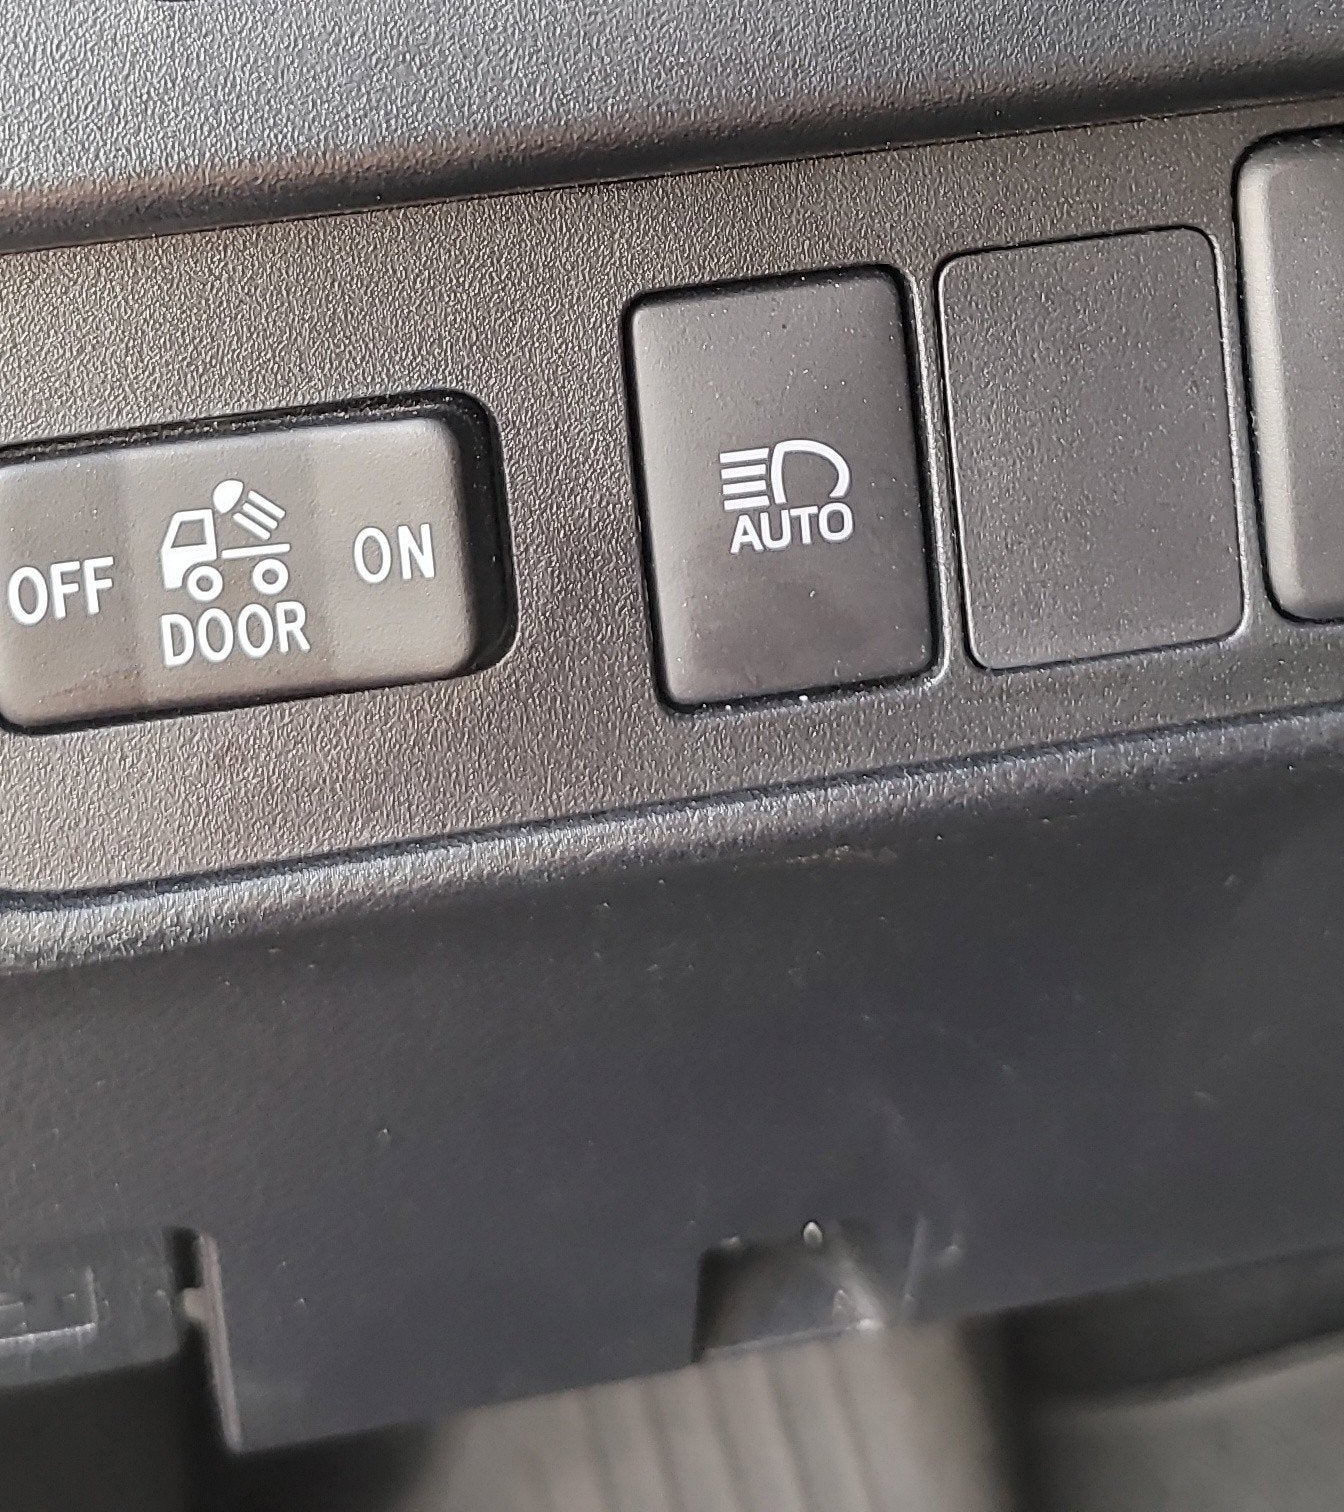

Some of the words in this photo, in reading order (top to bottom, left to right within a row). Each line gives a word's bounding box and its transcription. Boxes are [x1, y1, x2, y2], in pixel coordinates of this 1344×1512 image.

[354, 523, 436, 584] ON
[730, 502, 854, 554] AUTO
[7, 556, 115, 626] OFF
[160, 601, 312, 667] DOOR
